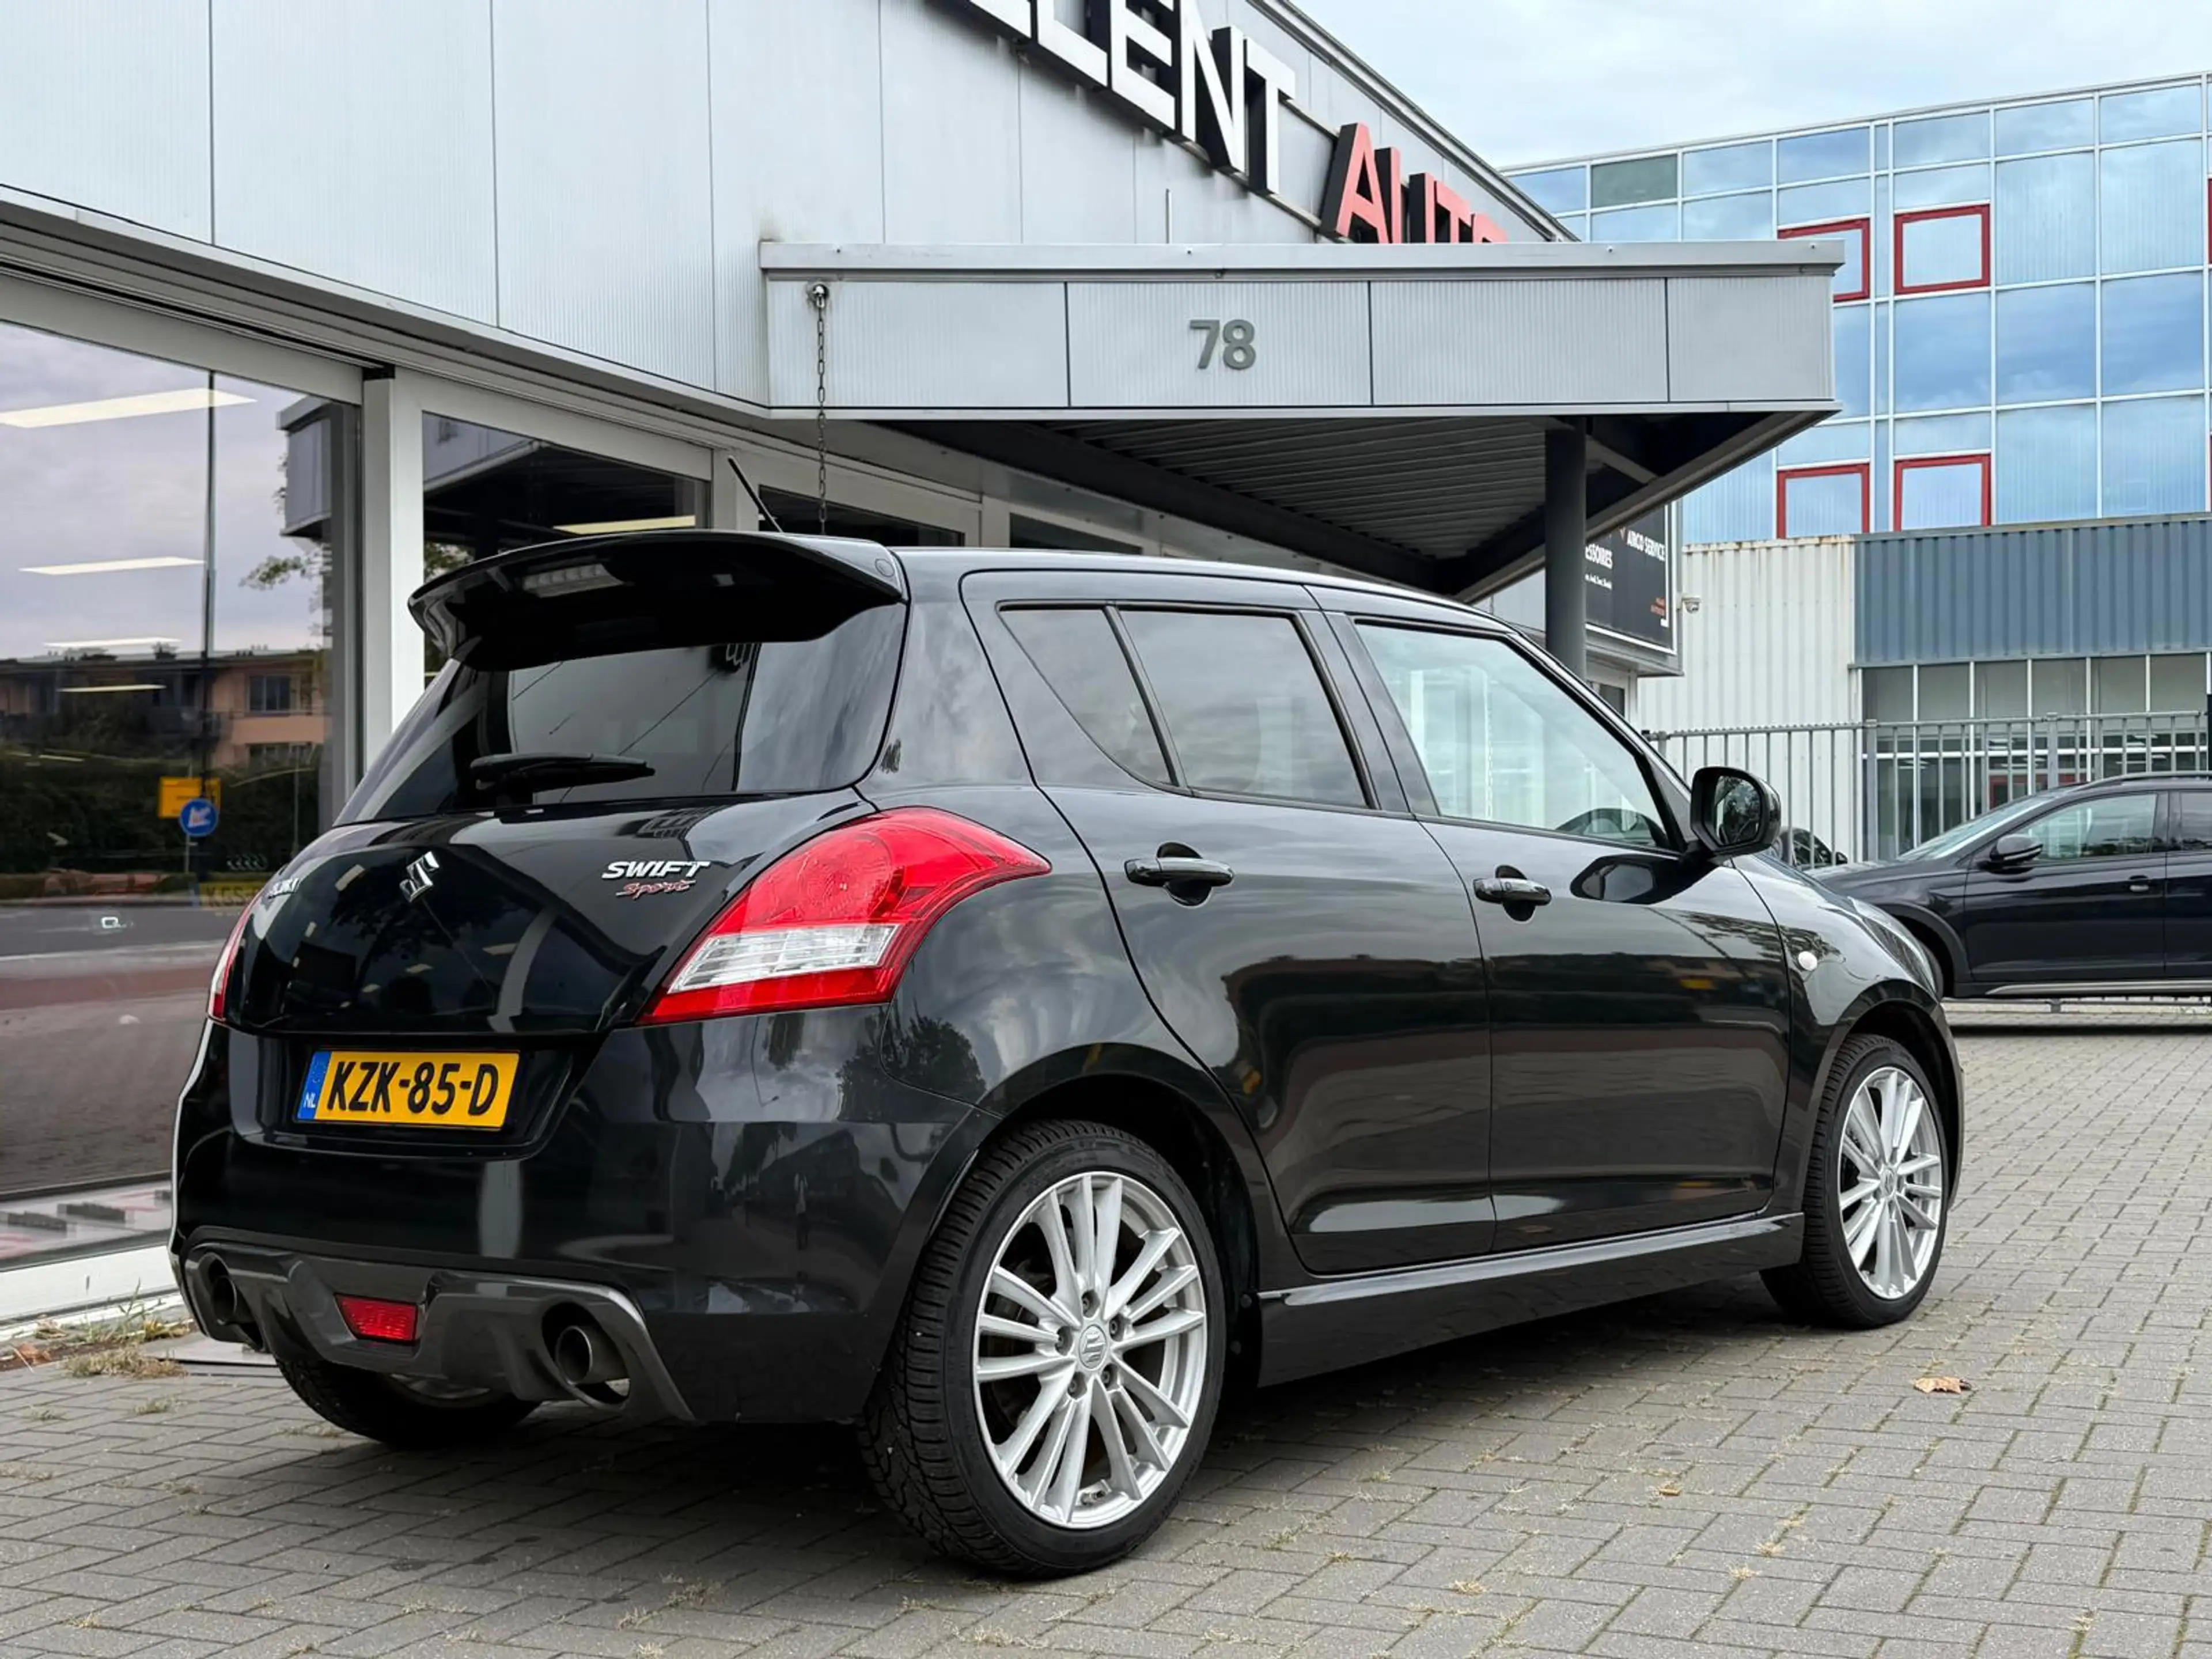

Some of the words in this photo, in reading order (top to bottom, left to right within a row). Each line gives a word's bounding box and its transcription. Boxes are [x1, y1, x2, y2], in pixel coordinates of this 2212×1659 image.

[970, 0, 1296, 194] LENT
[1190, 319, 1256, 370] 78
[601, 861, 710, 879] SWIFT
[615, 879, 696, 899] Sport
[303, 1092, 316, 1109] NL
[327, 1061, 499, 1116] KZK-85-D
